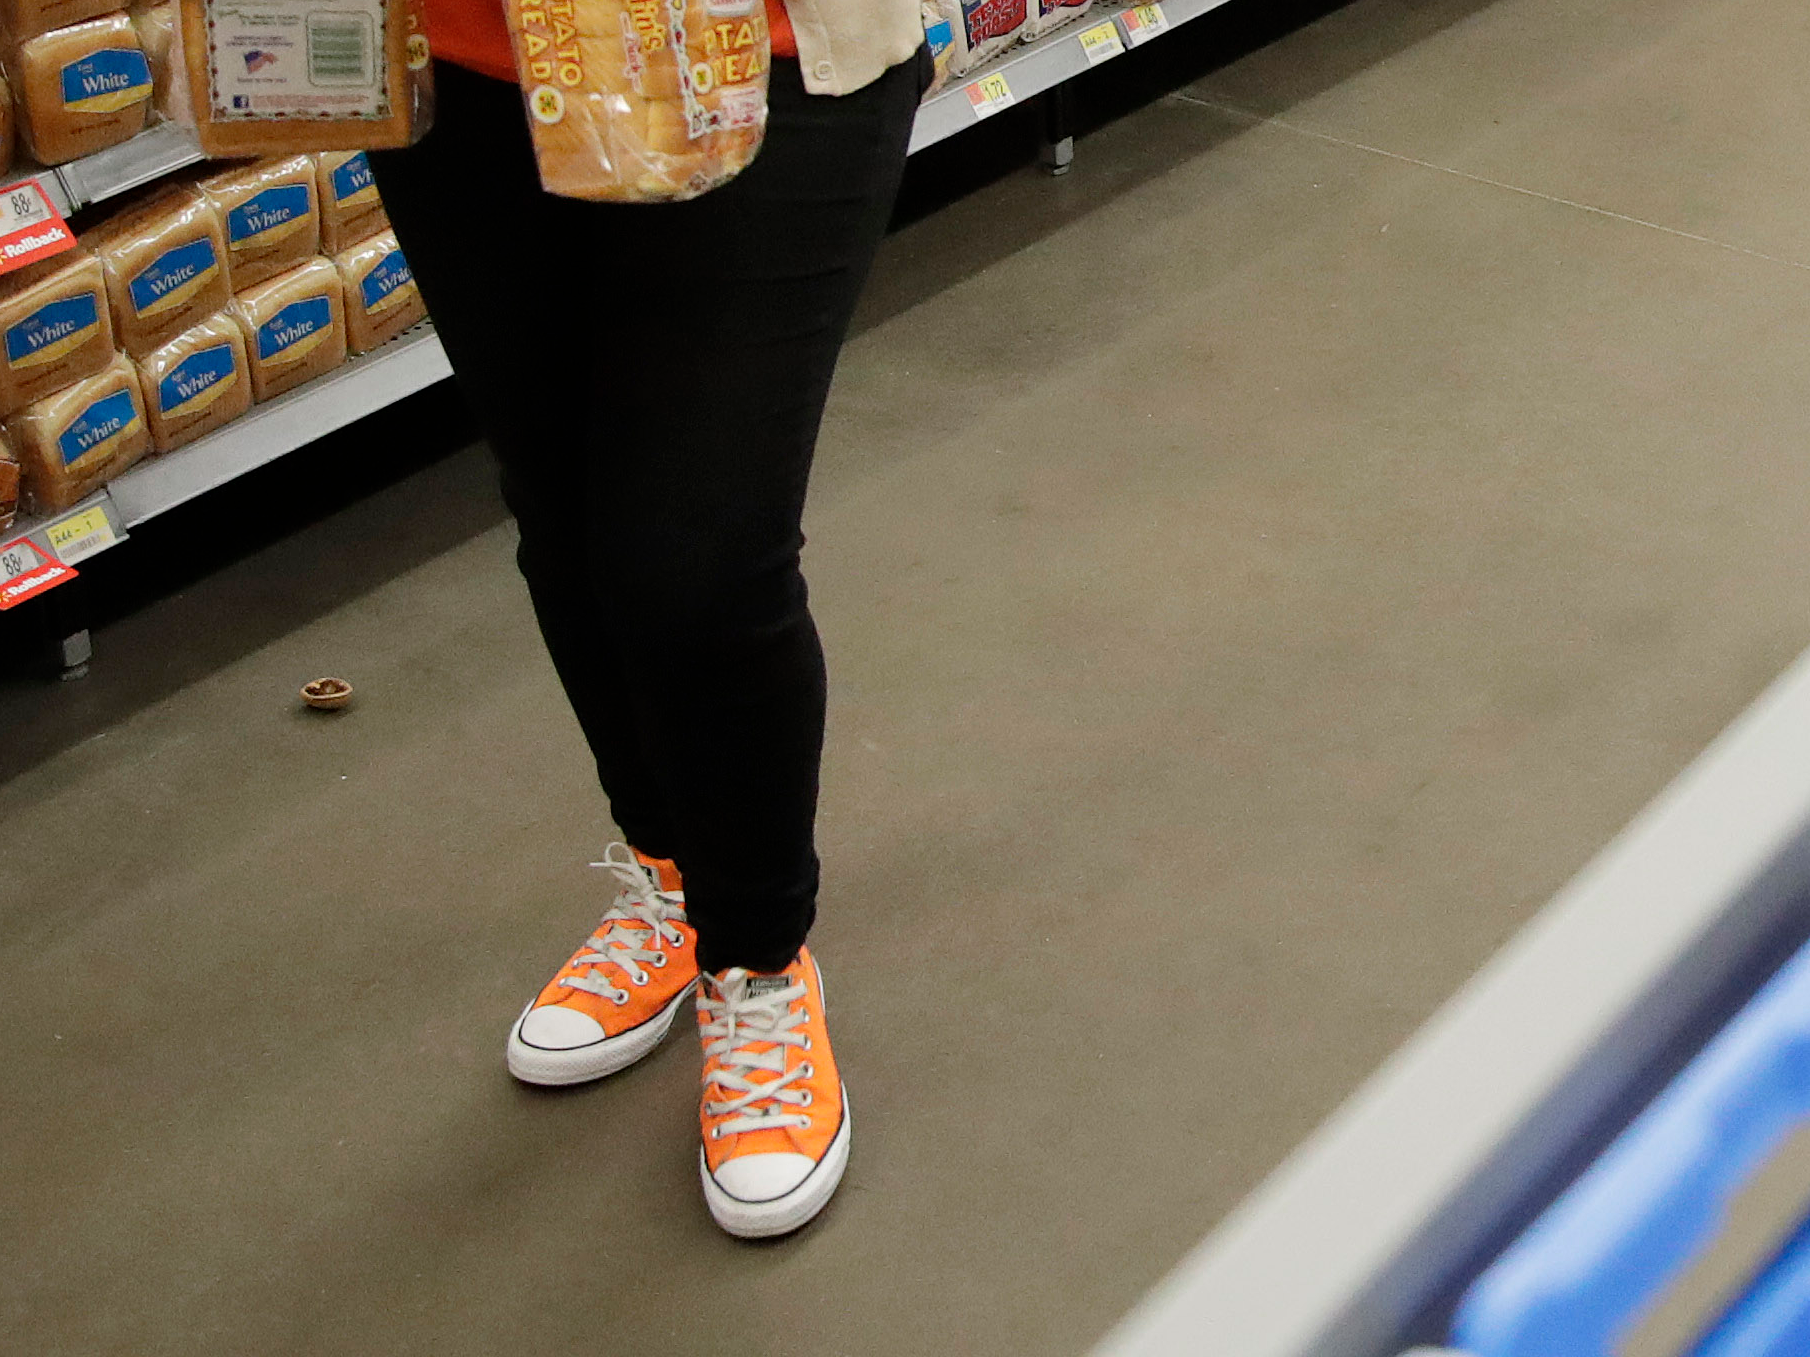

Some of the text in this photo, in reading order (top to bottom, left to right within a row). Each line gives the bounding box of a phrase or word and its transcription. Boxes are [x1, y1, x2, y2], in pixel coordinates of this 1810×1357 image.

[82, 72, 130, 94] White
[247, 207, 290, 232] White
[4, 227, 66, 258] Rollback
[151, 263, 195, 295] White
[27, 320, 75, 348] White
[274, 318, 314, 348] White
[177, 370, 217, 399] White
[77, 417, 120, 449] White
[7, 567, 67, 596] Rollback
